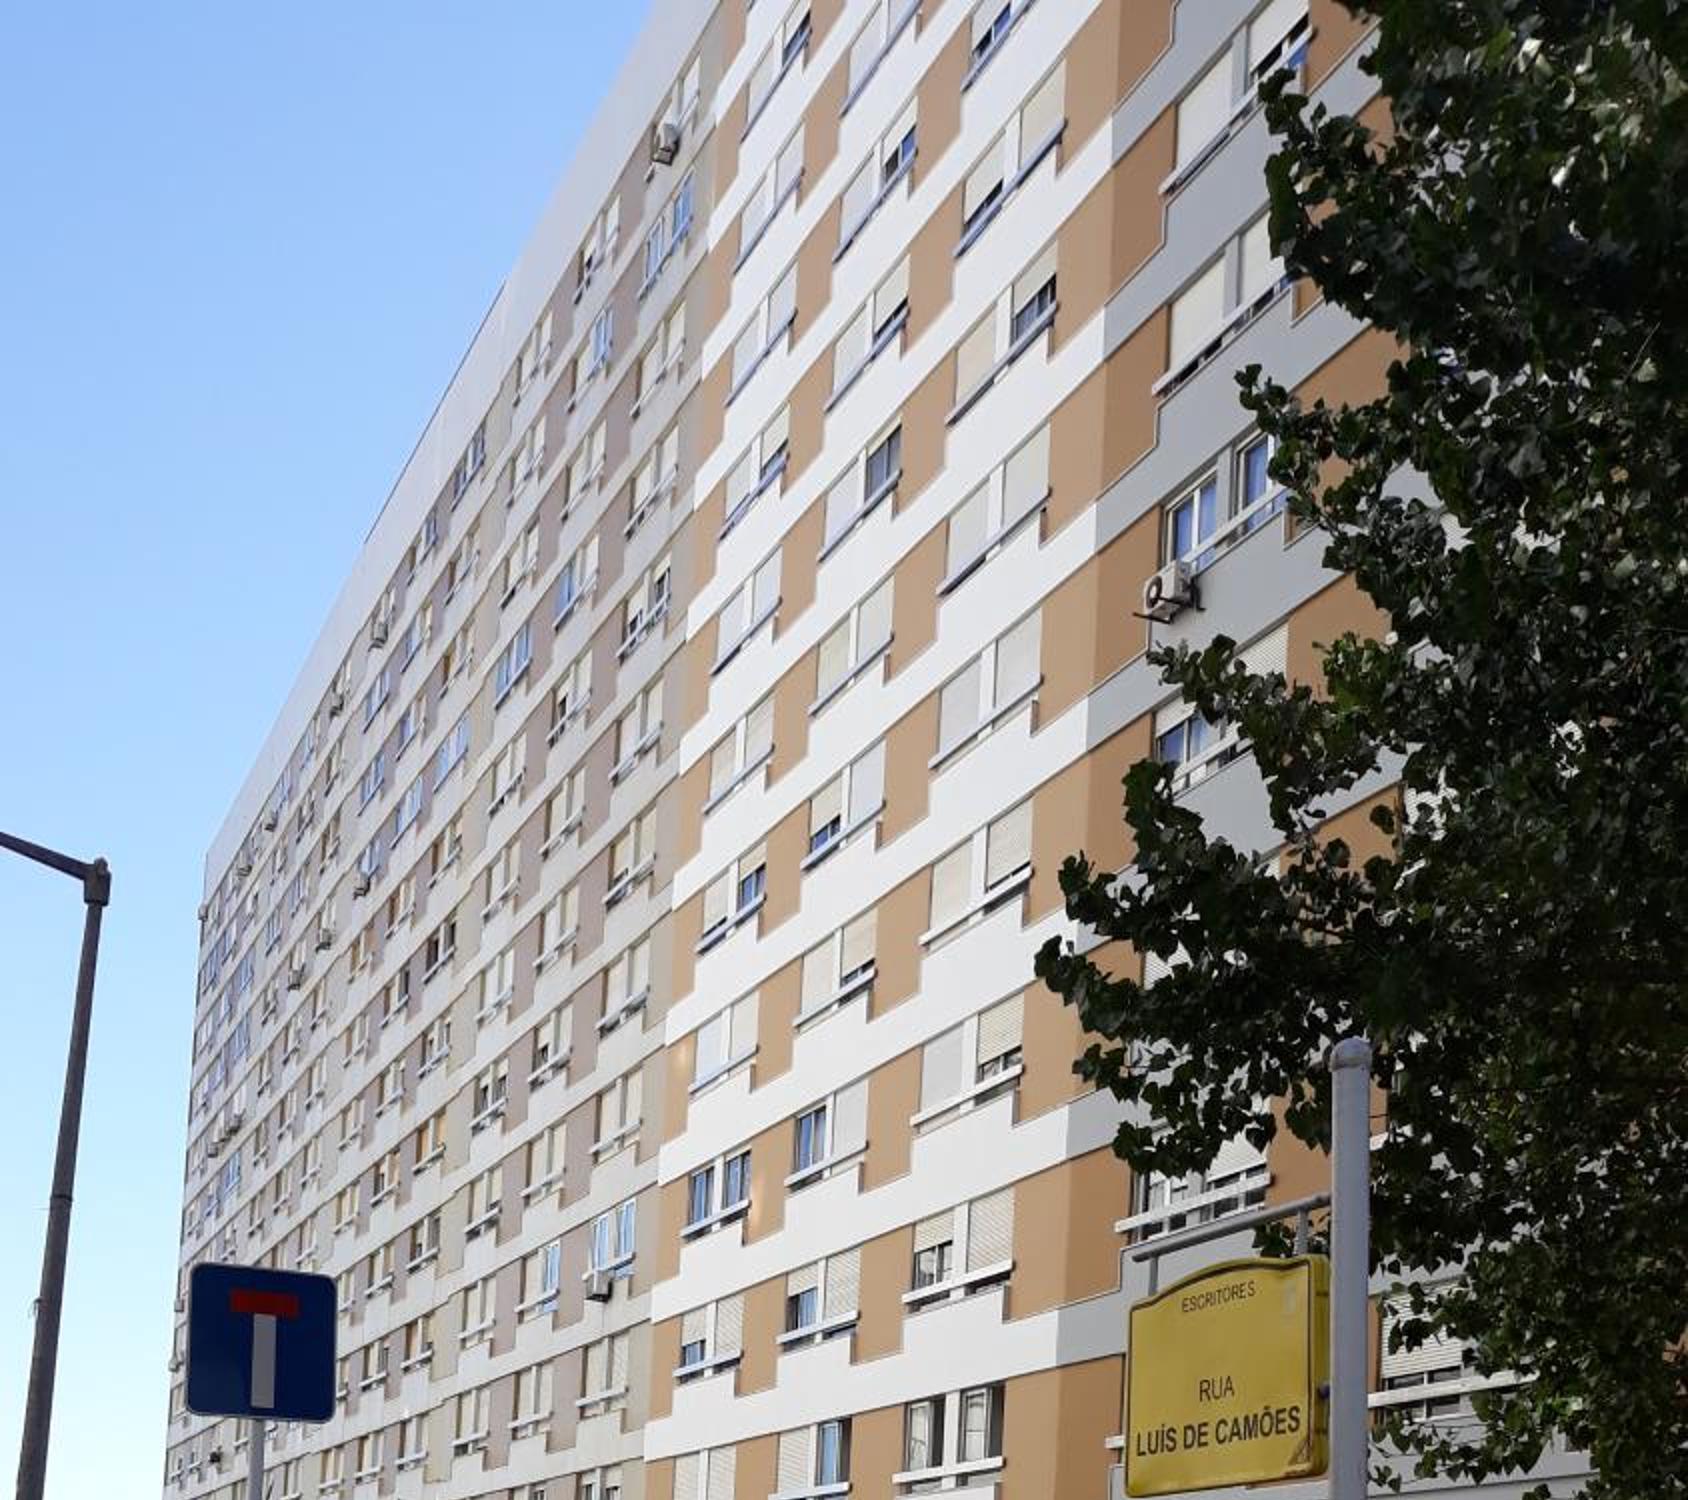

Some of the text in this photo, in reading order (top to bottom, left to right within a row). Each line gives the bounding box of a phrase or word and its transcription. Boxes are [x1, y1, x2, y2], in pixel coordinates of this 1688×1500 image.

[1181, 1280, 1256, 1312] ESCRITORES
[1199, 1376, 1235, 1402] RUA
[1136, 1405, 1301, 1456] LUÍS DE CAMÕES
